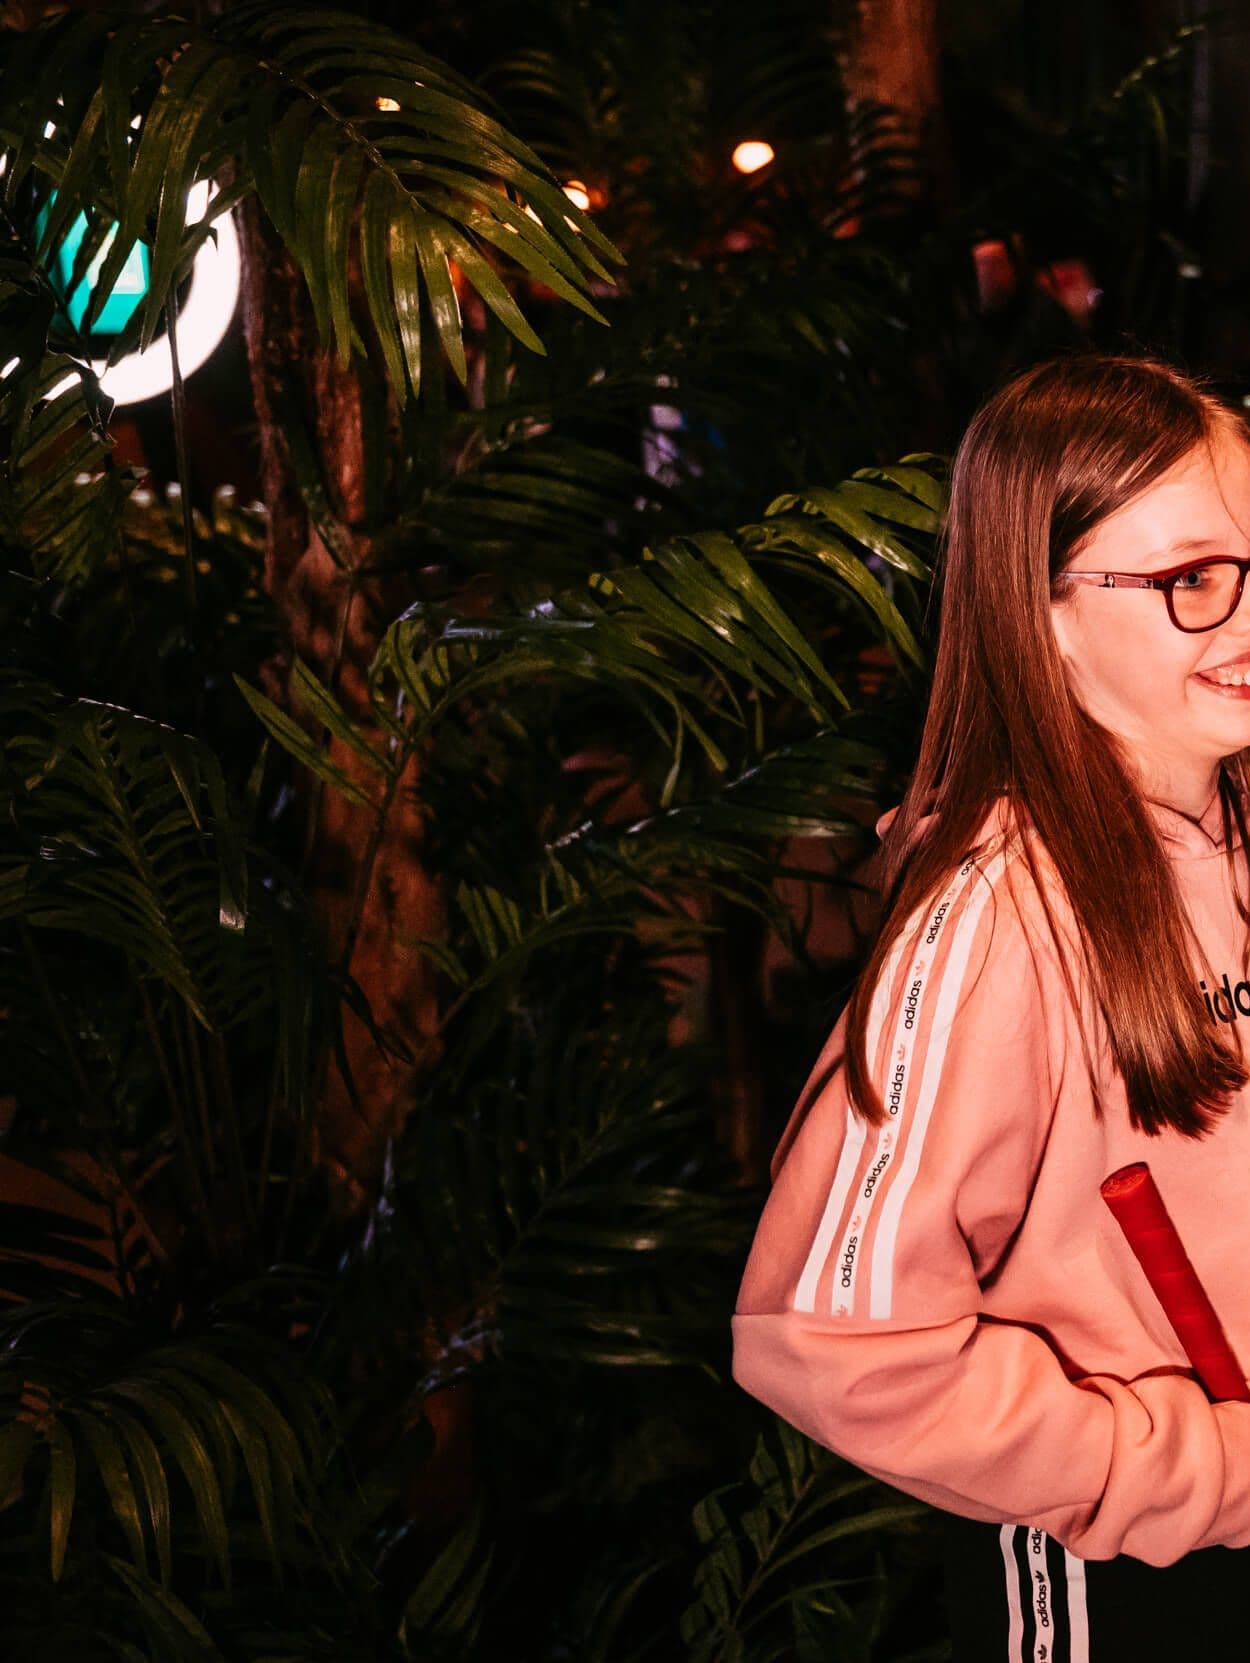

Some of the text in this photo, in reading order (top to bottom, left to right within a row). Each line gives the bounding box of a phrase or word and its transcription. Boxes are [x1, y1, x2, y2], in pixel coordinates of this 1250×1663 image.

[926, 901, 950, 944] adidas
[904, 979, 922, 1030] adidas
[889, 1064, 905, 1115] adidas
[864, 1153, 890, 1198] adidas
[841, 1236, 858, 1288] adidas
[1036, 1584, 1049, 1627] adidas
